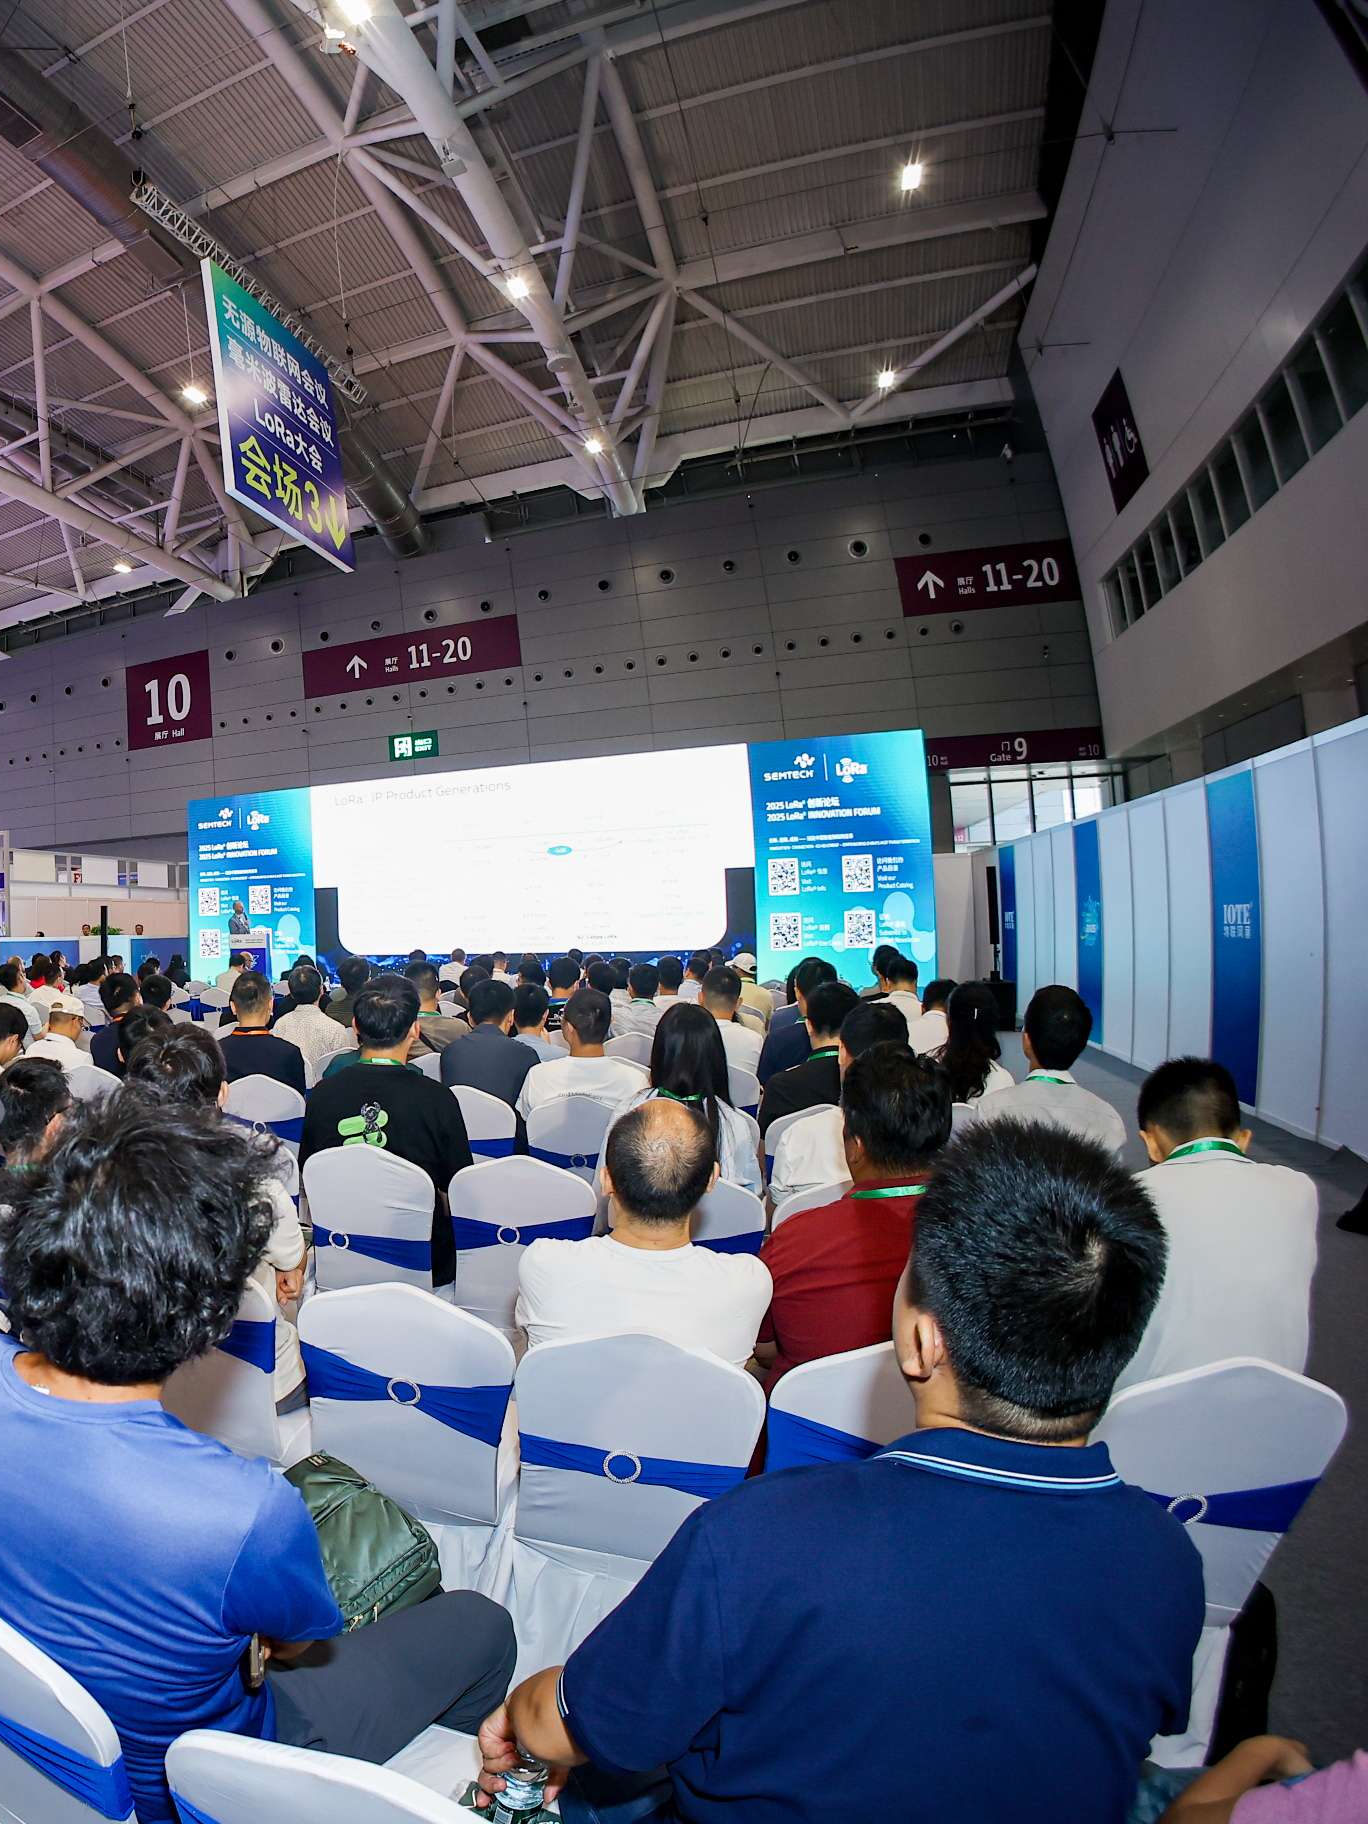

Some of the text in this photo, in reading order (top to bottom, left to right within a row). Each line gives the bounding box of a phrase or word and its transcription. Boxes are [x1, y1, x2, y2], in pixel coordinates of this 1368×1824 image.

[222, 294, 330, 410] 无源物联网会议
[253, 397, 322, 474] LoRa大会
[982, 557, 1060, 592] 11-20
[957, 577, 974, 586] 展厅
[959, 587, 976, 595] Halls
[407, 636, 472, 670] 11-20
[384, 656, 399, 666] 展厅
[144, 673, 192, 726] 10
[154, 728, 185, 741] 展厅 Hall
[414, 744, 432, 753] EXIT
[1001, 741, 1010, 752] 门
[1014, 737, 1027, 760] 9
[1088, 744, 1099, 756] 10
[928, 754, 938, 767] 10
[990, 753, 1012, 762] Gate
[763, 769, 814, 782] SEMTECH
[386, 787, 432, 801] Product
[435, 782, 511, 797] Generations
[766, 802, 784, 810] 2025
[767, 813, 785, 822] 2025
[807, 808, 853, 819] INNOVATION
[854, 807, 881, 817] FORUM
[197, 820, 232, 829] SEMTECH
[1223, 903, 1250, 925] IOTE
